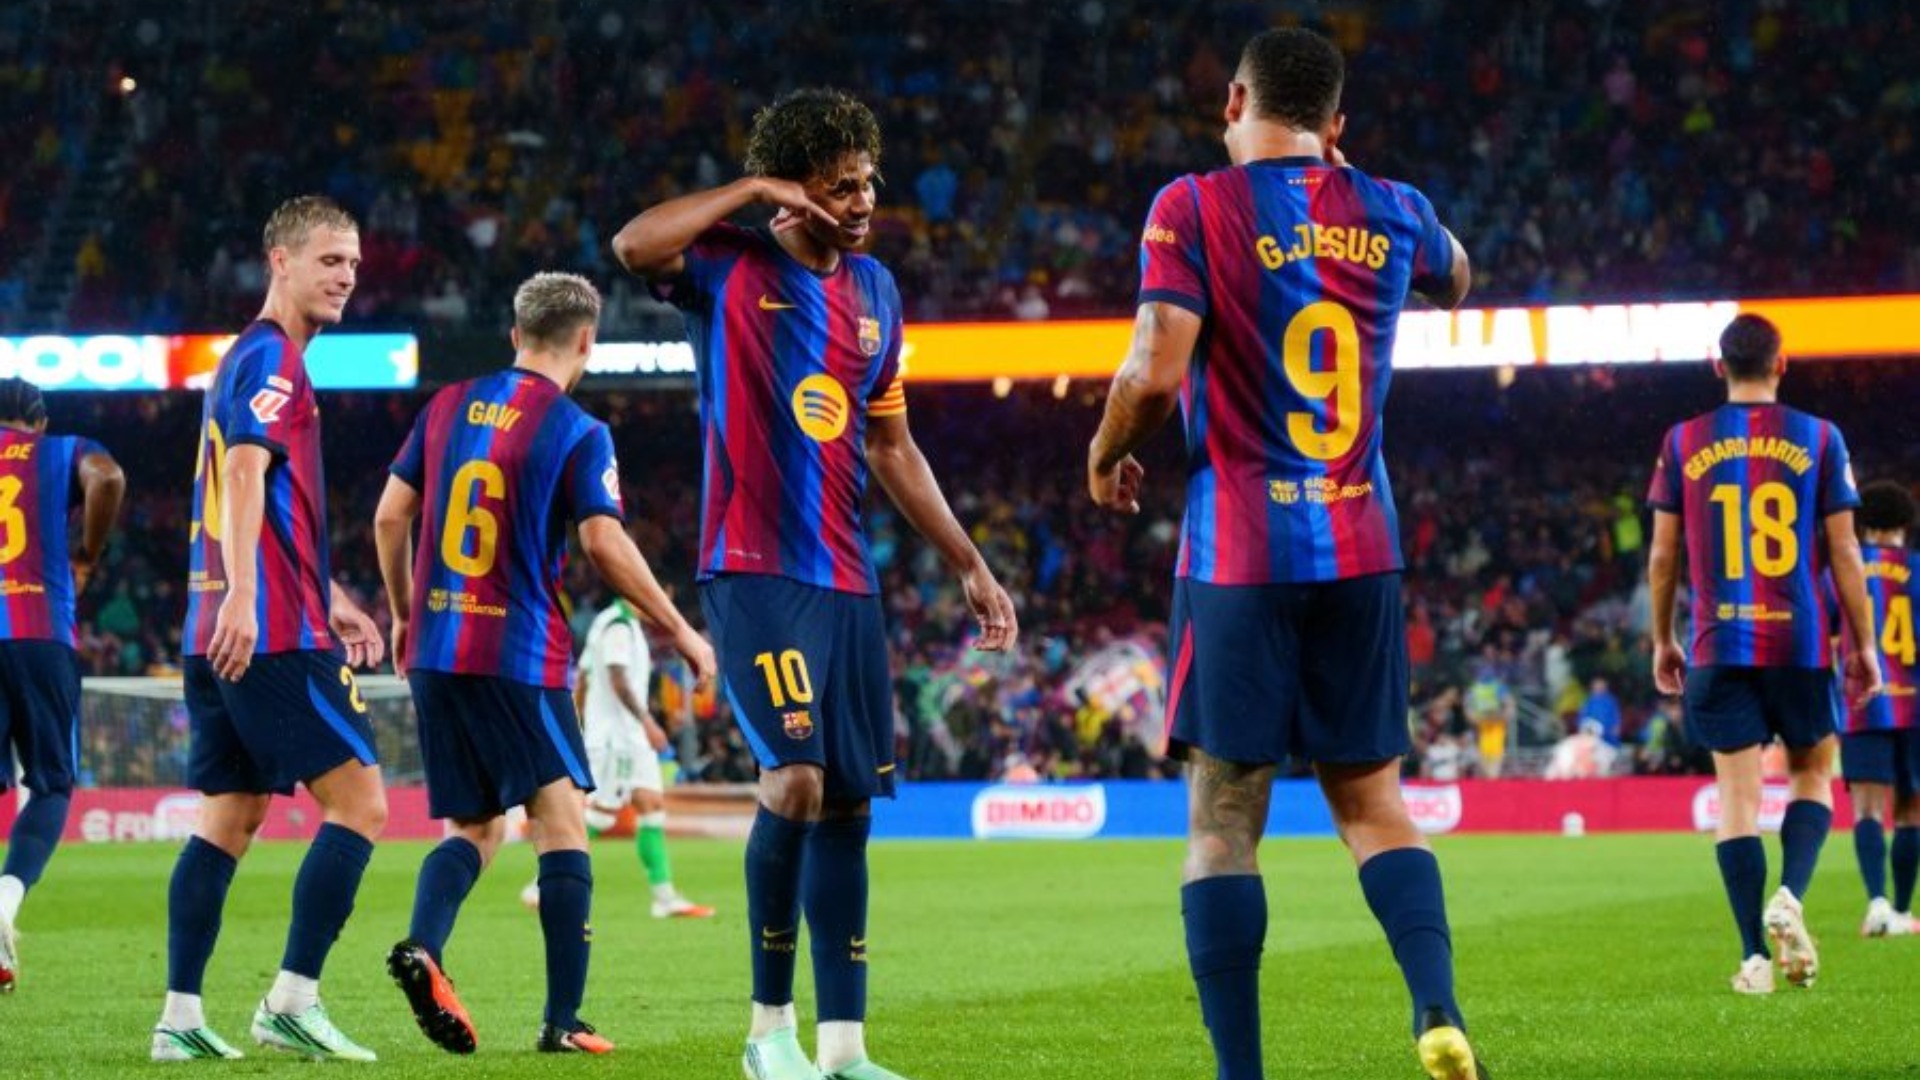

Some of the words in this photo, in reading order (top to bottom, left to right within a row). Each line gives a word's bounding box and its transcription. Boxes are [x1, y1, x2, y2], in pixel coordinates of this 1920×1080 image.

[1256, 224, 1390, 270] G.JESUS
[1283, 300, 1361, 460] 9
[467, 400, 522, 432] GAVI
[1683, 437, 1747, 480] GERARD
[441, 459, 506, 578] 6
[1709, 481, 1798, 580] 18
[755, 648, 813, 707] 10
